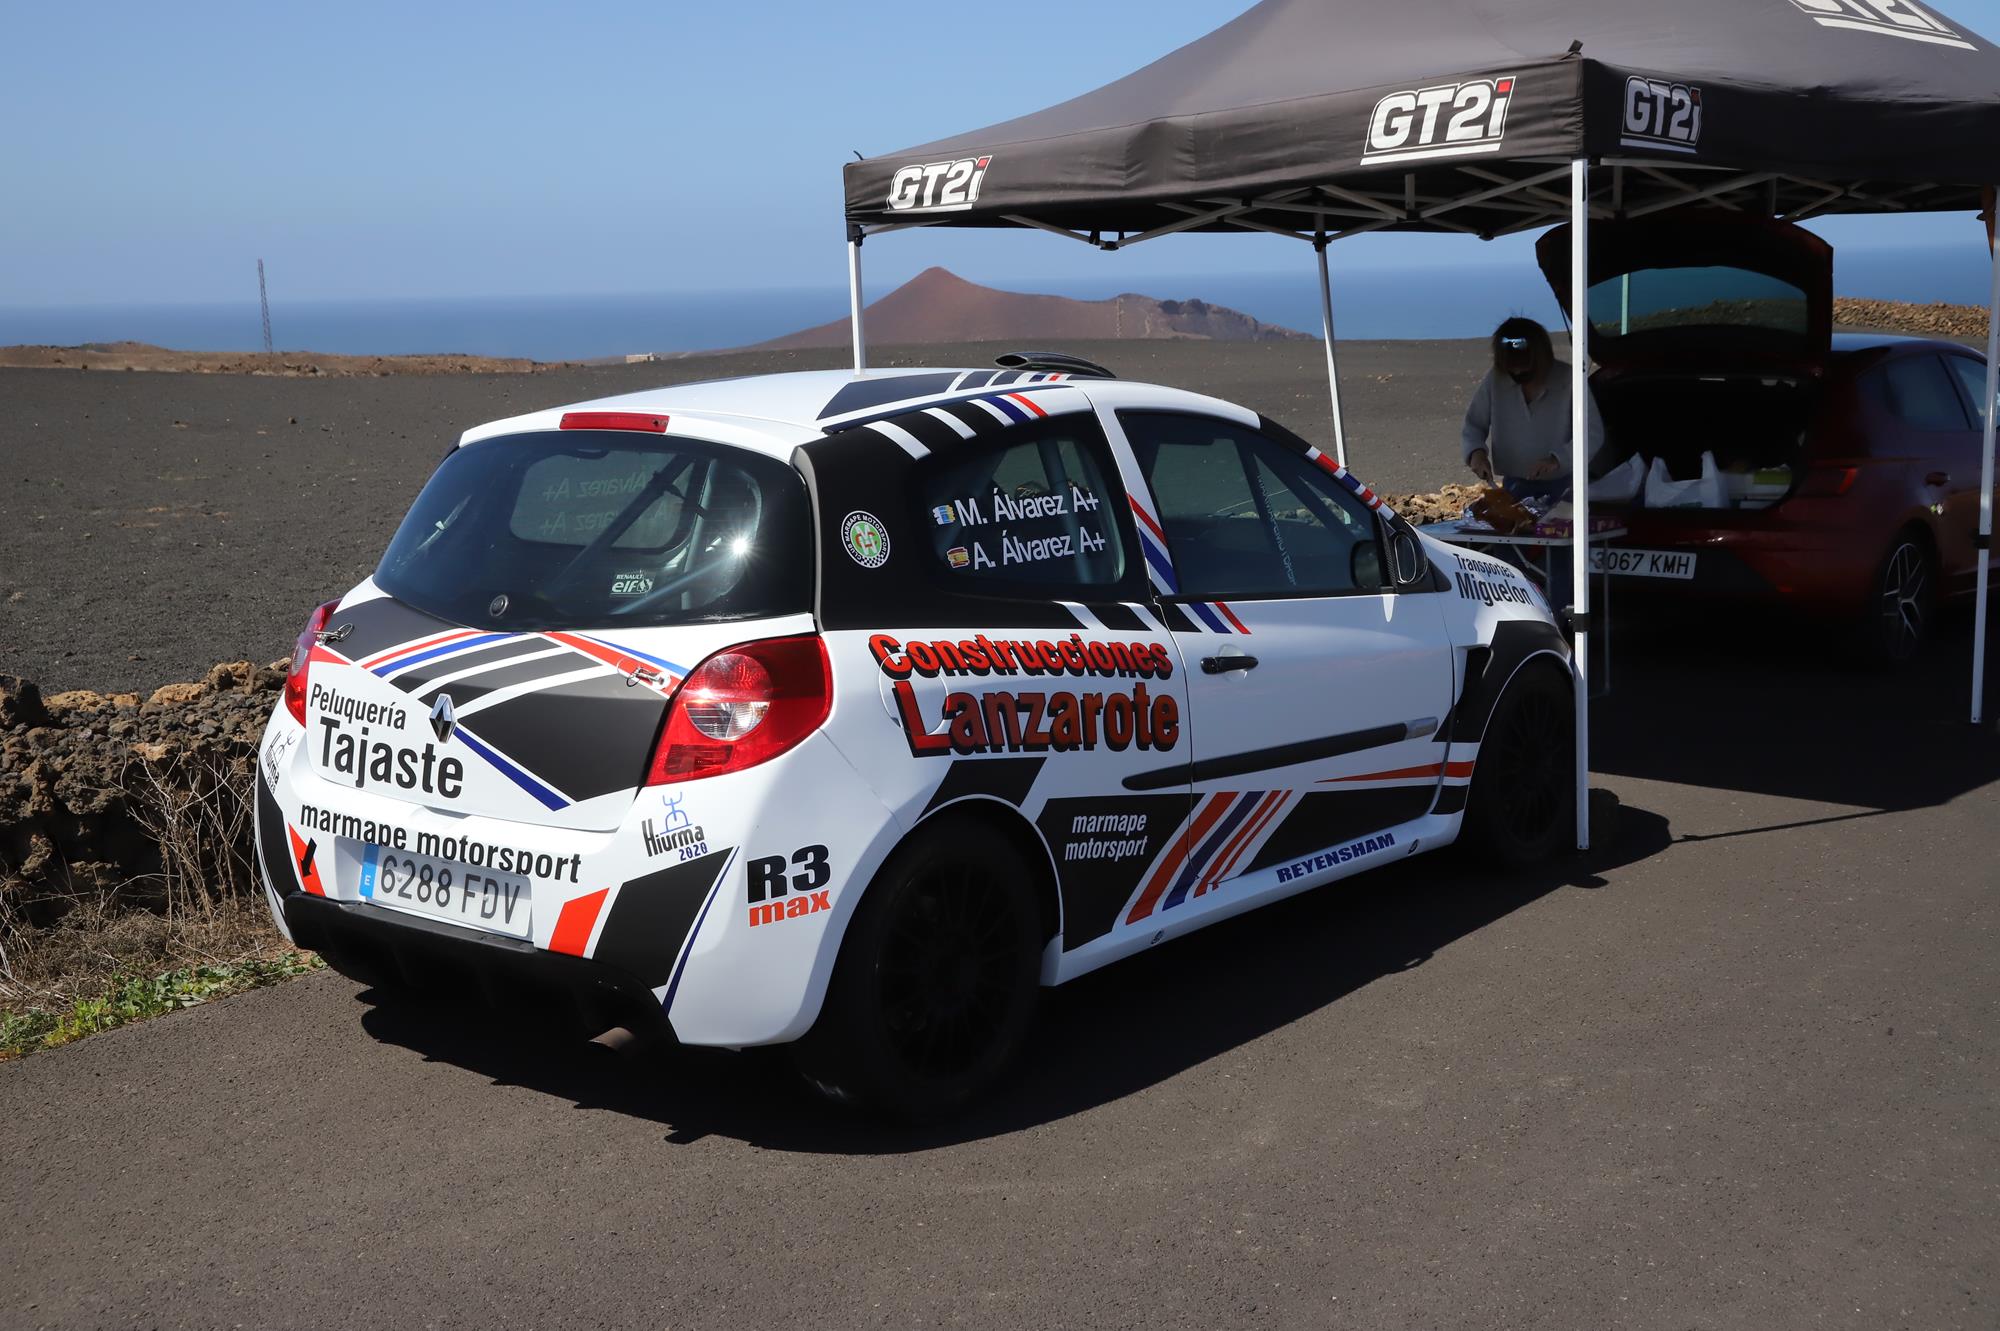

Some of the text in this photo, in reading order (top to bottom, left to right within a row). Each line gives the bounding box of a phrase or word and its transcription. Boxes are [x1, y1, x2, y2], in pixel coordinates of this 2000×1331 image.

[1368, 80, 1514, 150] GT2i
[1625, 81, 1701, 143] GT2i
[888, 158, 989, 210] GT2i
[954, 486, 1099, 527] M. Álvarez A+
[974, 526, 1106, 570] A. Álvarez A+
[1453, 553, 1515, 578] Transportes
[1649, 554, 1690, 575] KMH
[611, 580, 639, 593] elf
[1454, 571, 1535, 607] Miguelon
[868, 633, 1174, 681] Construcciones
[310, 683, 407, 730] Peluquería
[892, 682, 1180, 758] Lanzarote
[320, 716, 464, 799] Tajaste
[300, 804, 581, 884] marmape motorsport
[641, 818, 705, 857] Hiurma
[1071, 814, 1147, 836] marmape
[678, 841, 708, 861] 2020
[1065, 835, 1148, 862] motorsport
[1276, 832, 1396, 883] REYENSHAM
[380, 854, 521, 925] 6288 FDV
[747, 844, 831, 904] R3
[749, 890, 832, 928] max
